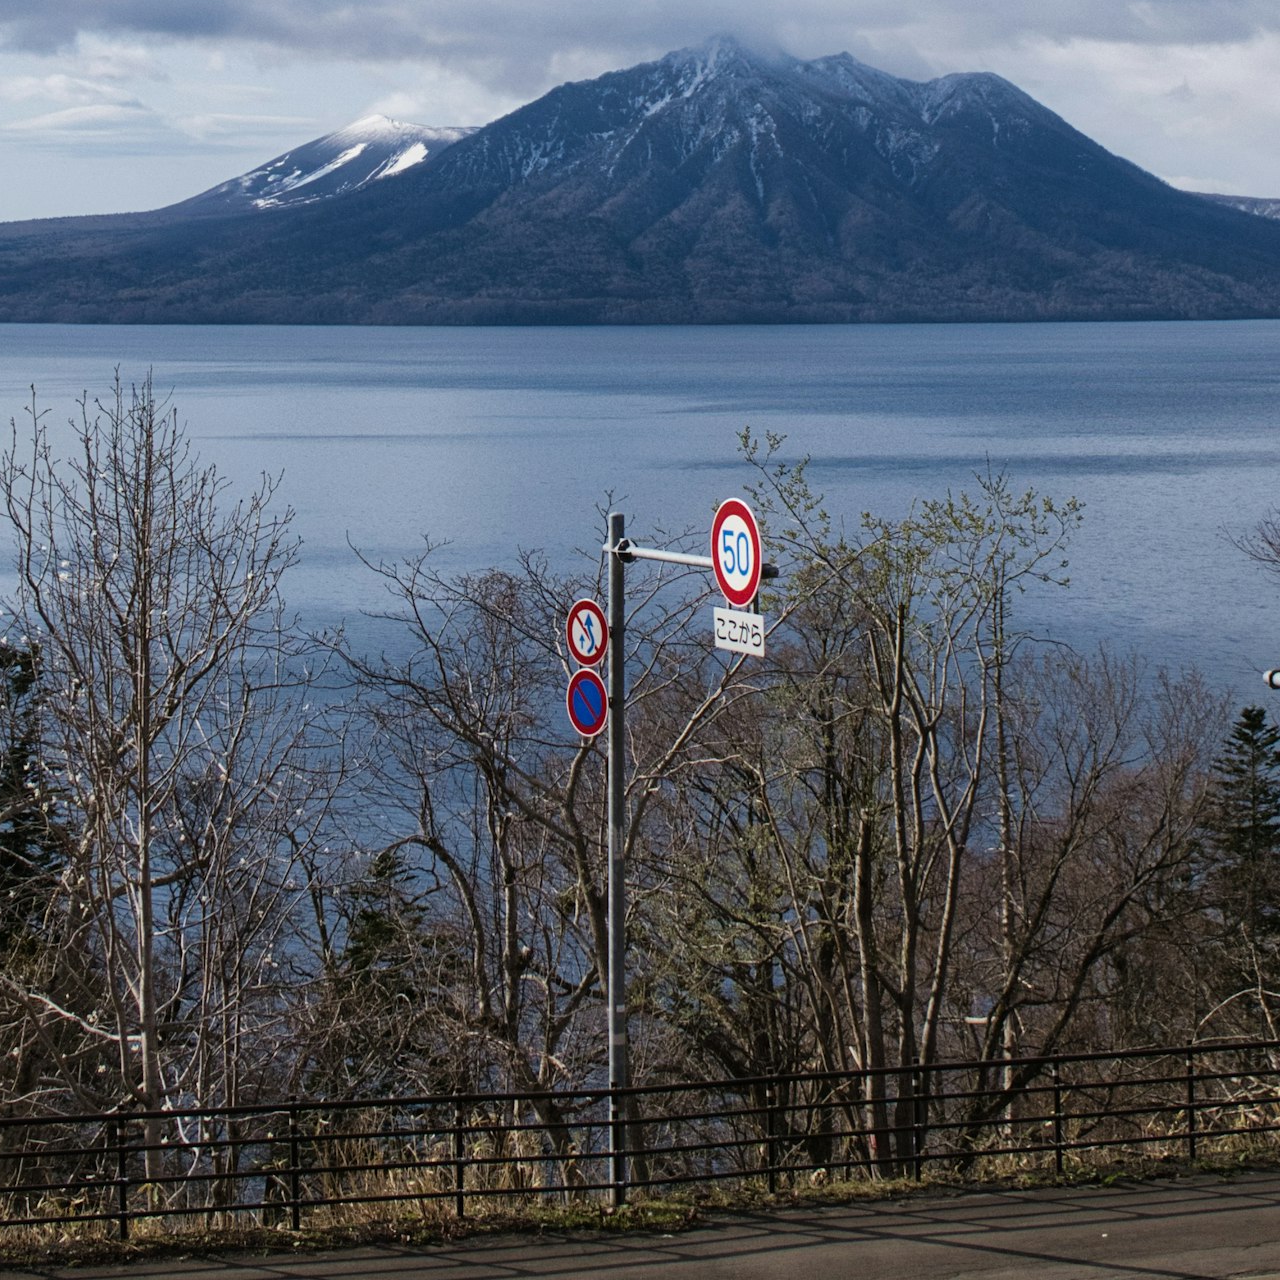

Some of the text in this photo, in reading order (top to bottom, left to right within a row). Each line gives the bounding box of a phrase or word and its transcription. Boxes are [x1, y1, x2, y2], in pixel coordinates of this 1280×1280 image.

[722, 529, 749, 576] 50
[716, 617, 762, 647] ここから
